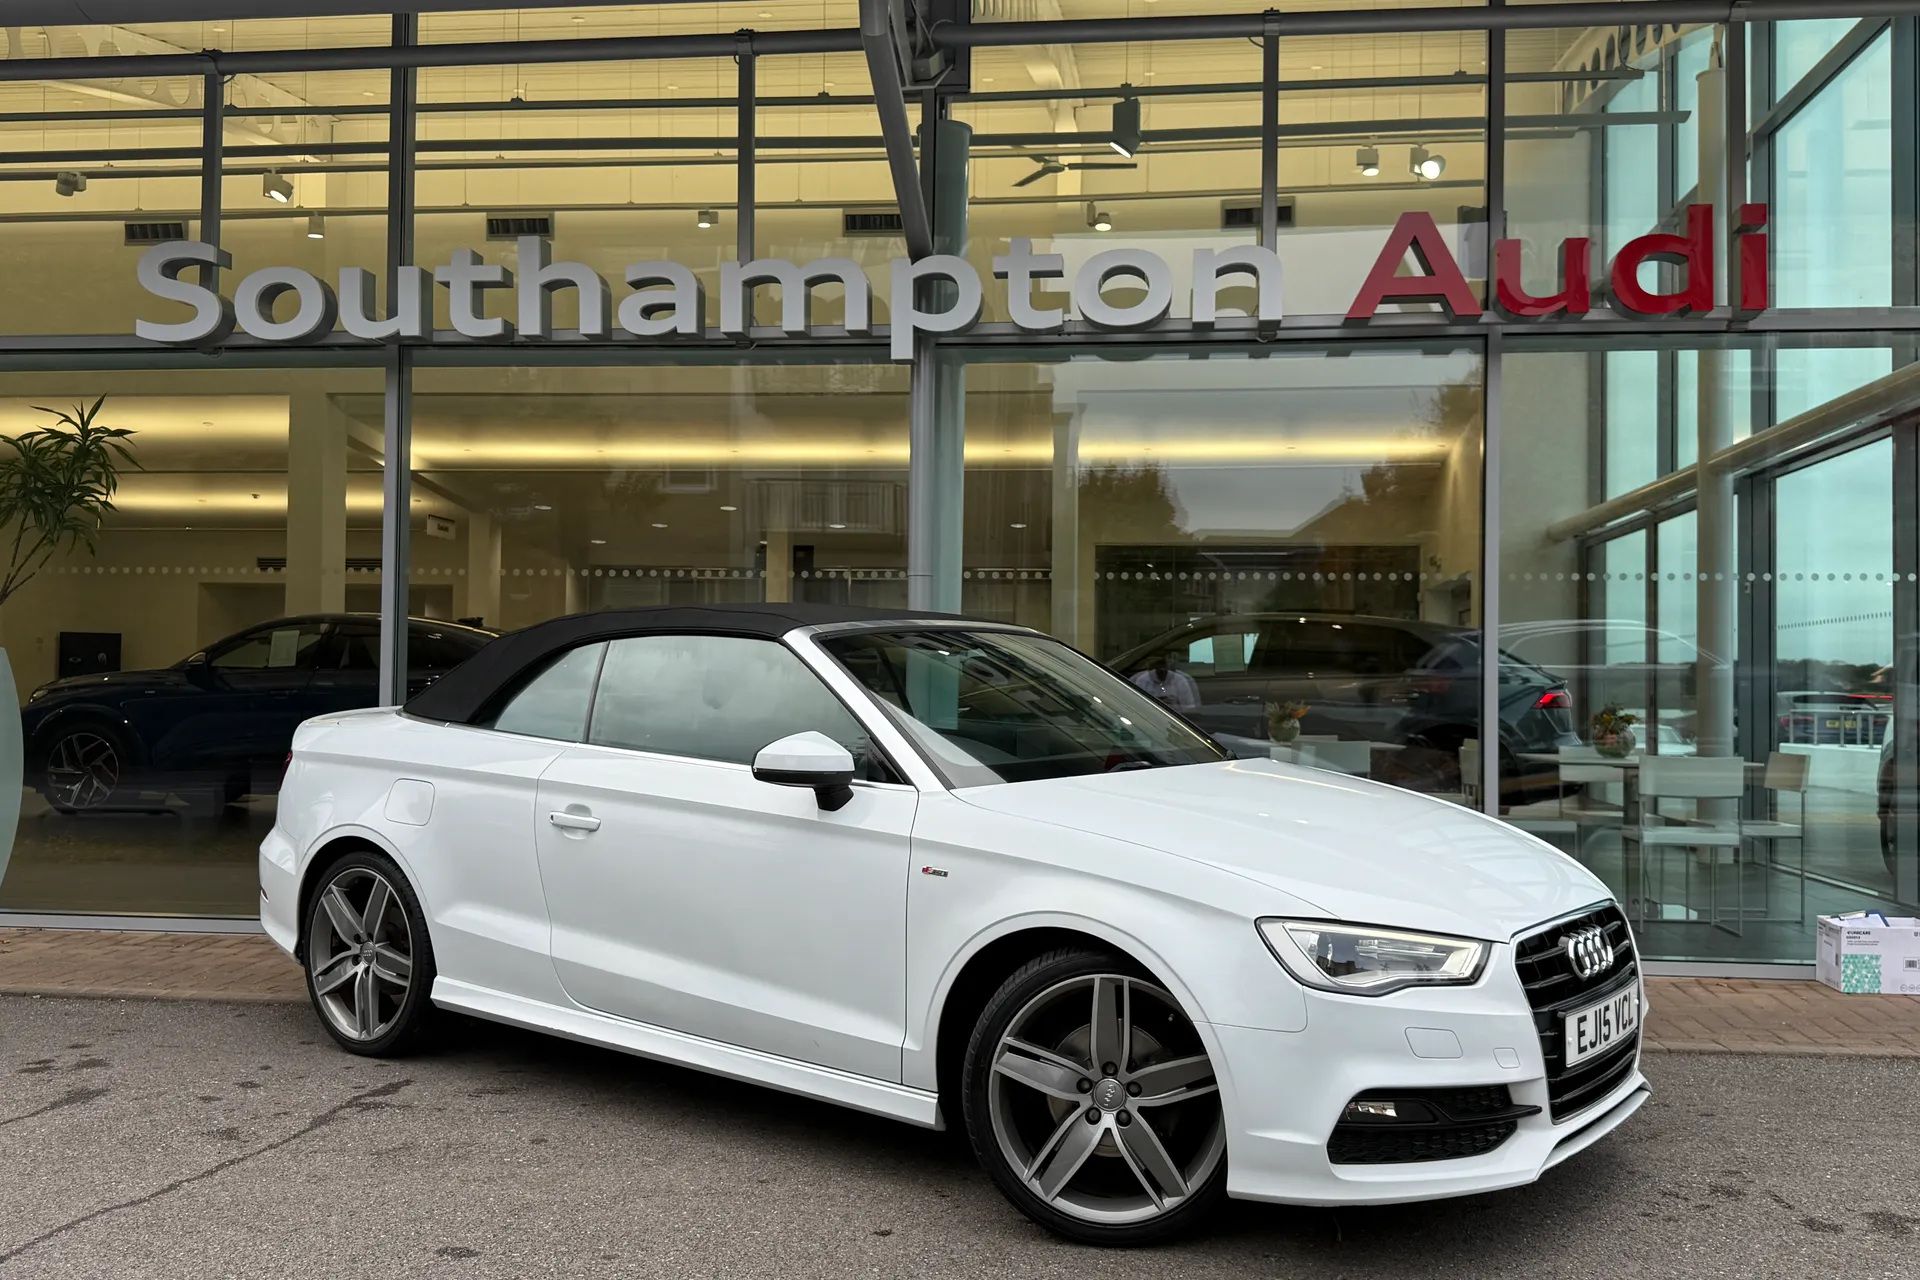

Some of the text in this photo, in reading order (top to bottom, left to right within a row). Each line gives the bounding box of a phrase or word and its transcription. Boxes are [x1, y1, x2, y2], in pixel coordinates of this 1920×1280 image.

[135, 203, 1768, 361] Southampton Audi
[1577, 992, 1634, 1054] EJ15 VCL
